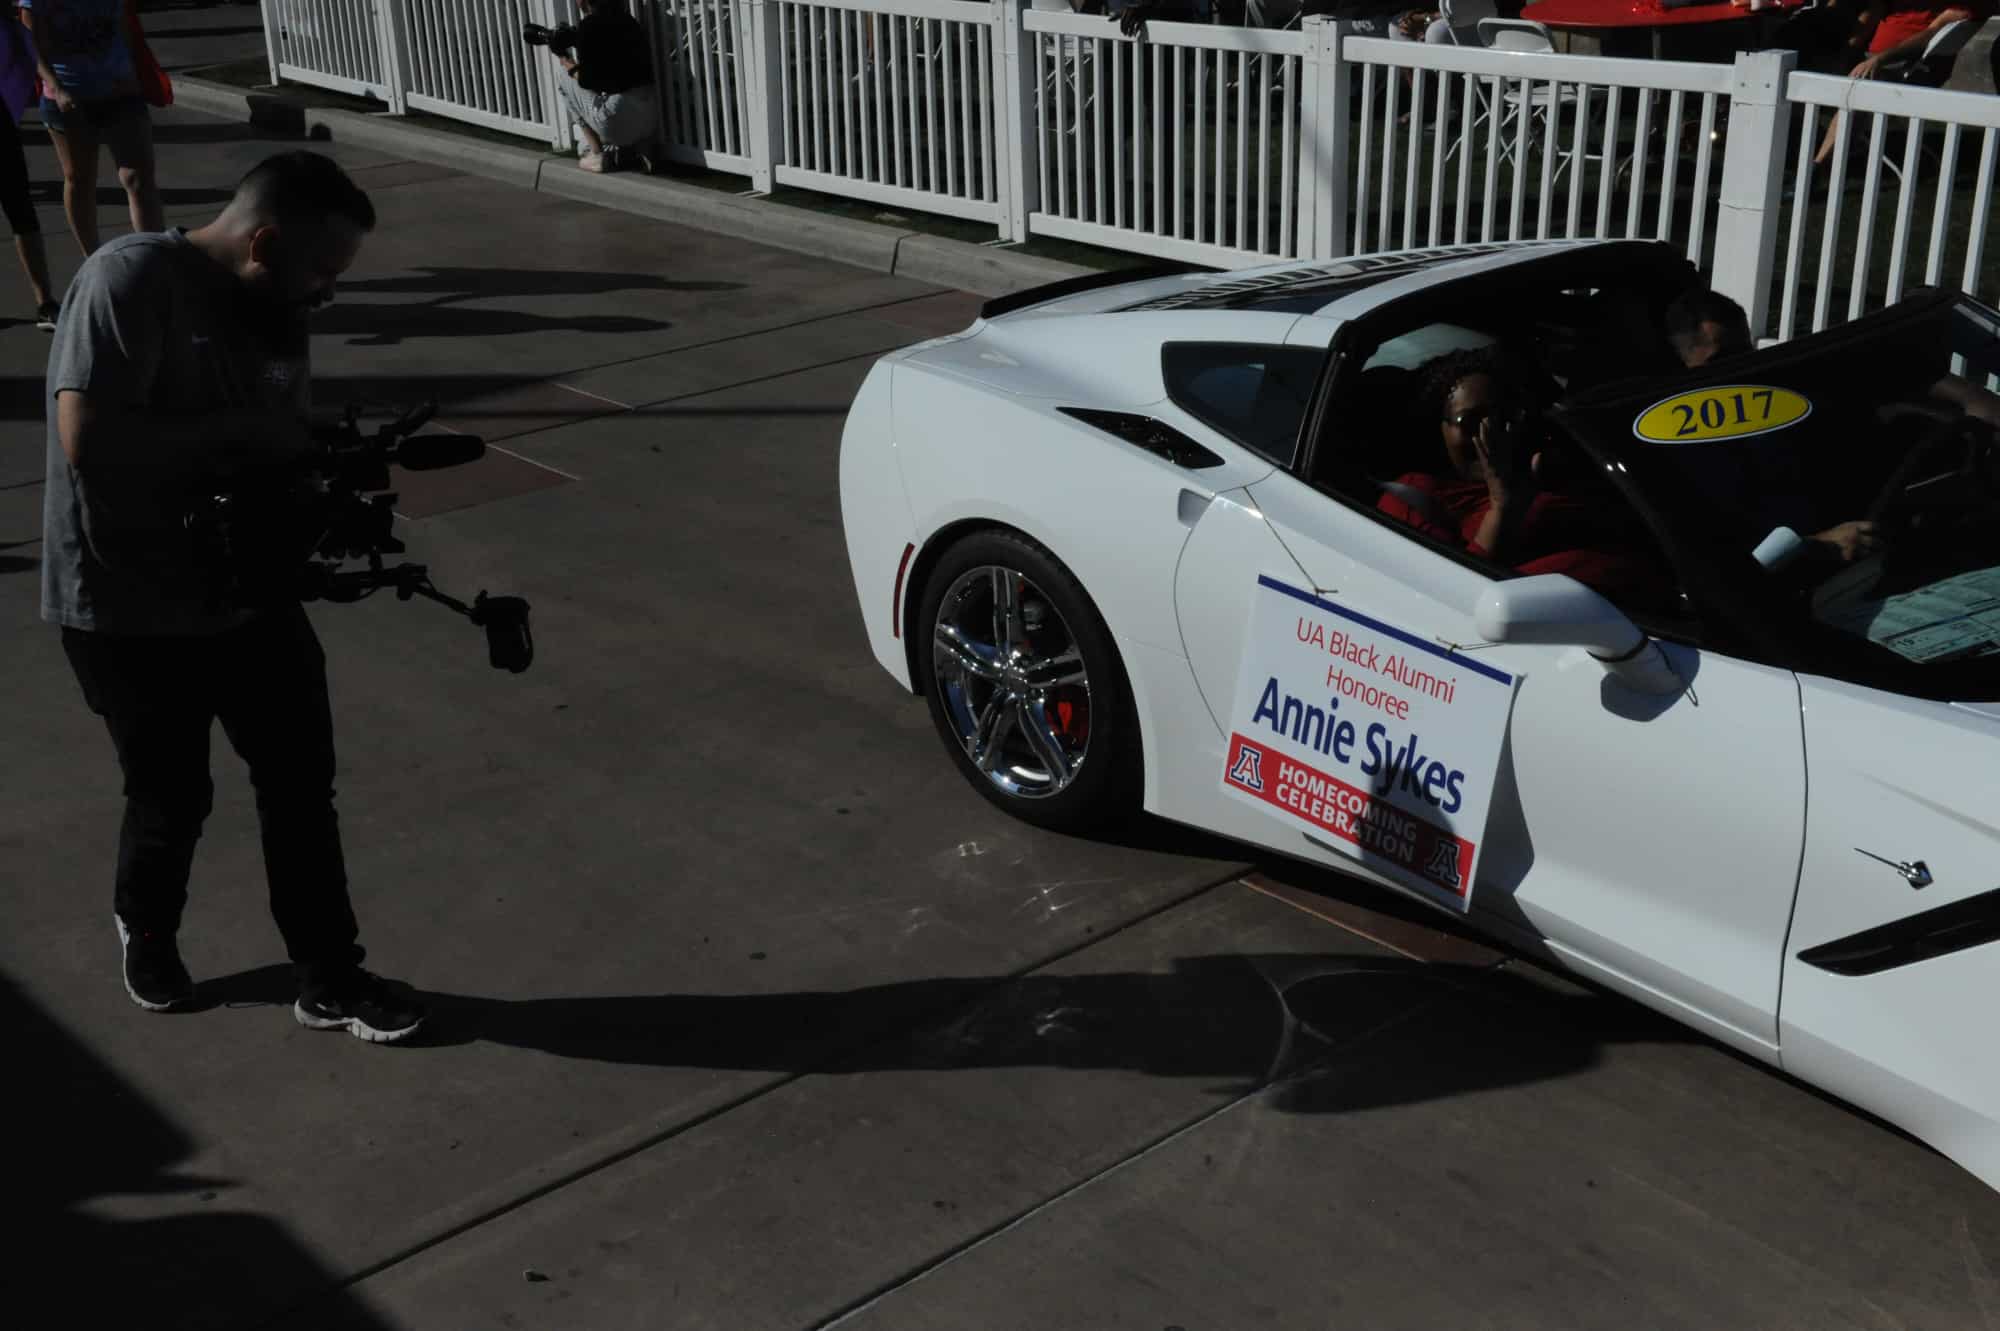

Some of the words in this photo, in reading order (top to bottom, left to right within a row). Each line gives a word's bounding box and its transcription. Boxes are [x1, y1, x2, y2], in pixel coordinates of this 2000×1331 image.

[1671, 390, 1774, 437] 2017
[1297, 616, 1325, 650] UA
[1329, 631, 1380, 673] Black
[1382, 655, 1457, 705] Alumni
[1326, 664, 1409, 721] Honoree
[1252, 676, 1356, 764] Annie
[1360, 722, 1465, 814] Sykes
[1276, 785, 1415, 863] CELEBRATION
[1278, 761, 1417, 841] HOMECOMING
